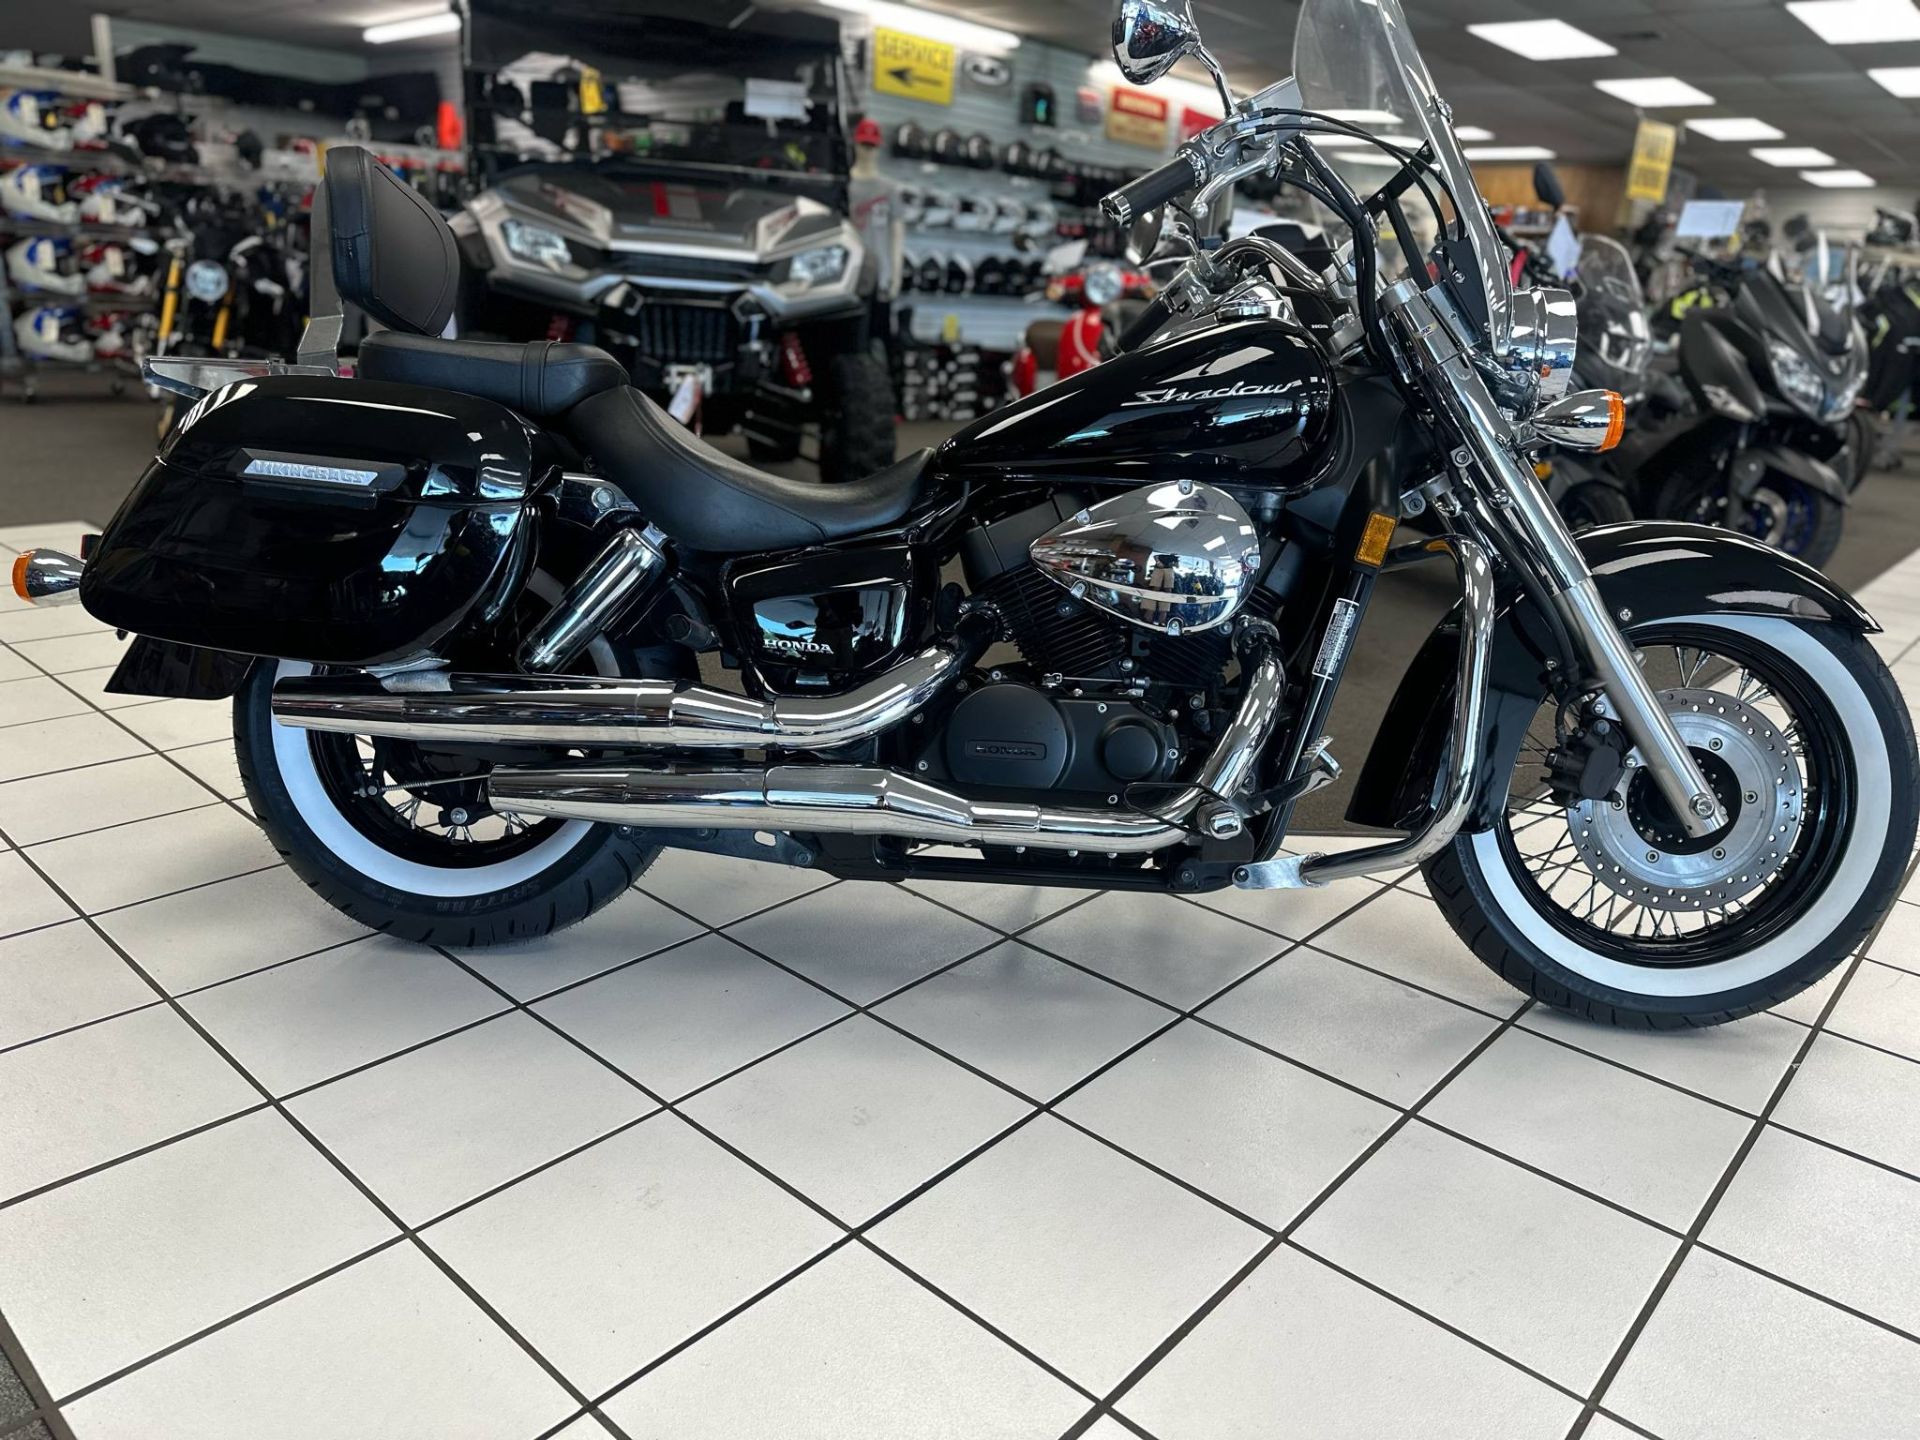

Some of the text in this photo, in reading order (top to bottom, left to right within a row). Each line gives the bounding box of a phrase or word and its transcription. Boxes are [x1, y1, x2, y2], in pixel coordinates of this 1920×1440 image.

[880, 33, 949, 72] SERVICE
[1120, 380, 1303, 406] Shadow
[762, 639, 834, 655] HONDA
[975, 743, 1038, 757] HONDA
